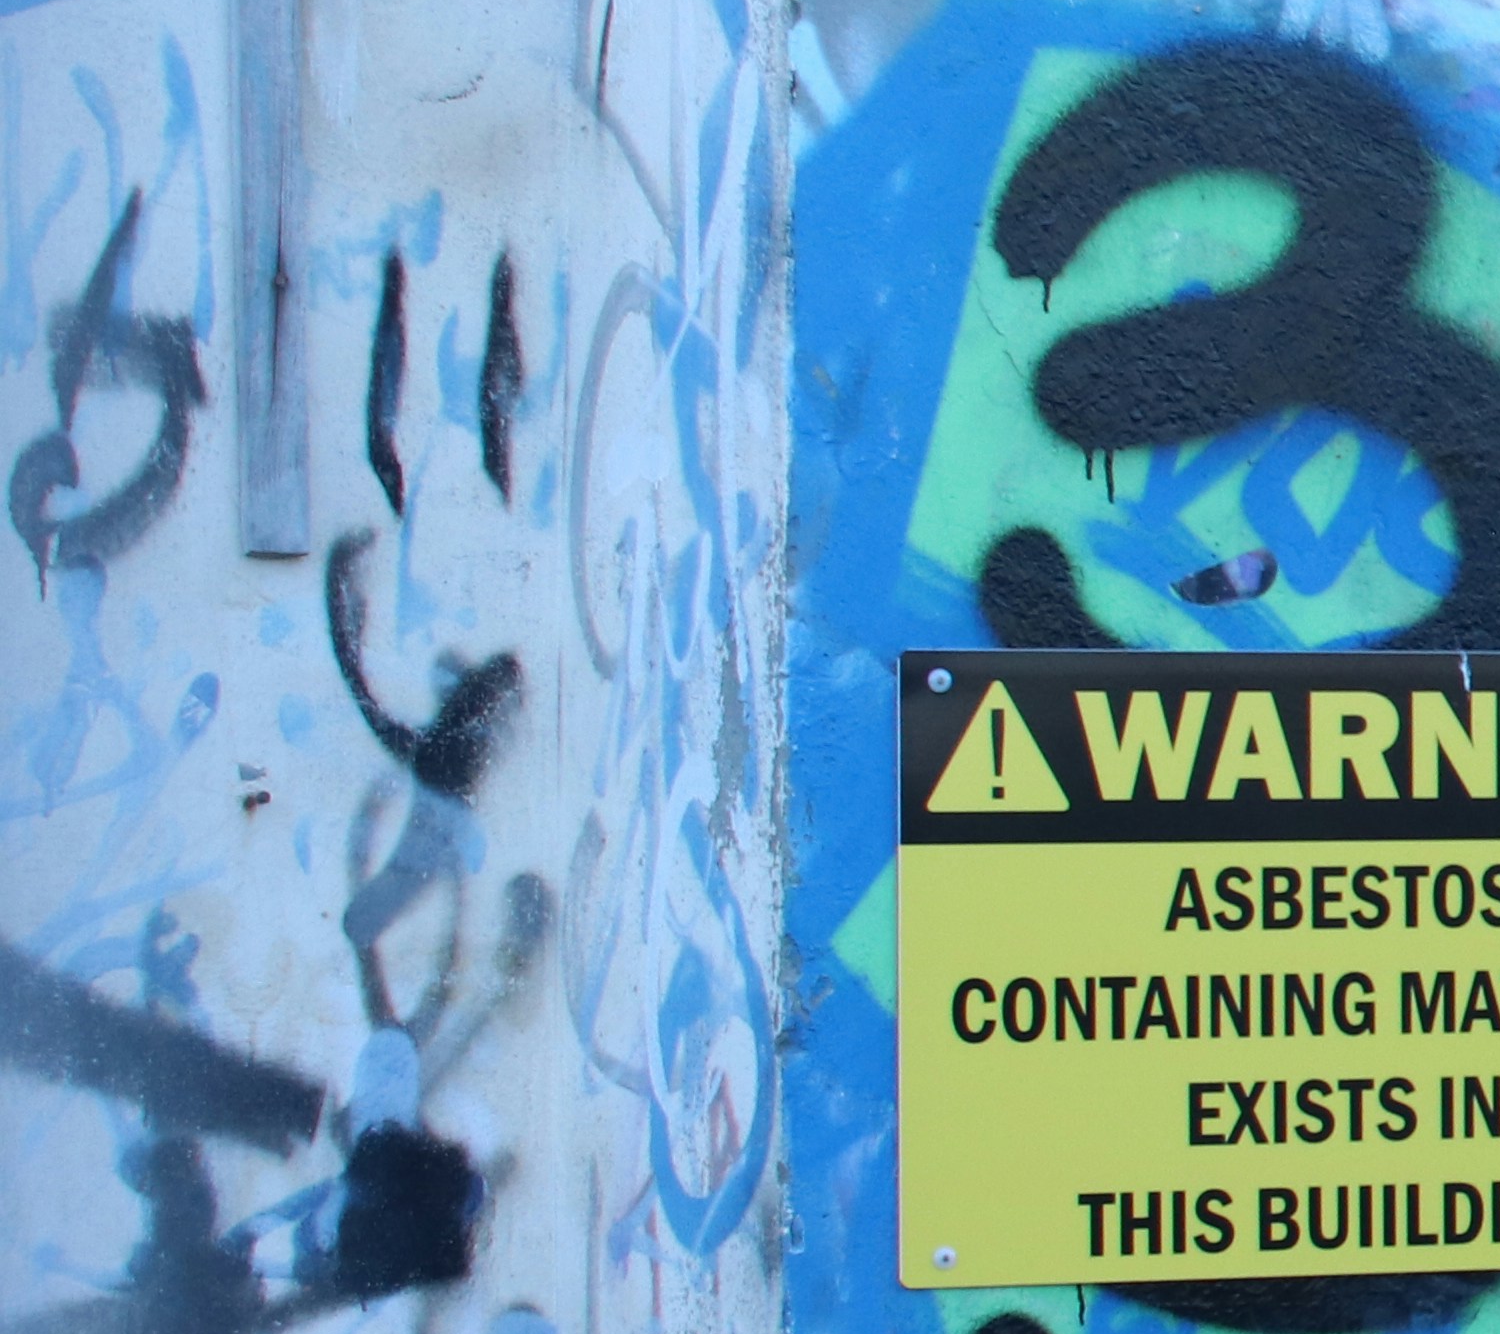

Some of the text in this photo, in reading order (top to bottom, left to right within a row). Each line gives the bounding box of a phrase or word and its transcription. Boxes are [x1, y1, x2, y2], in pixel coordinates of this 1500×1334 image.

[951, 971, 1375, 1044] CONTAINING
[1188, 1077, 1418, 1146] EXISTS
[1077, 1188, 1235, 1257] THIS
